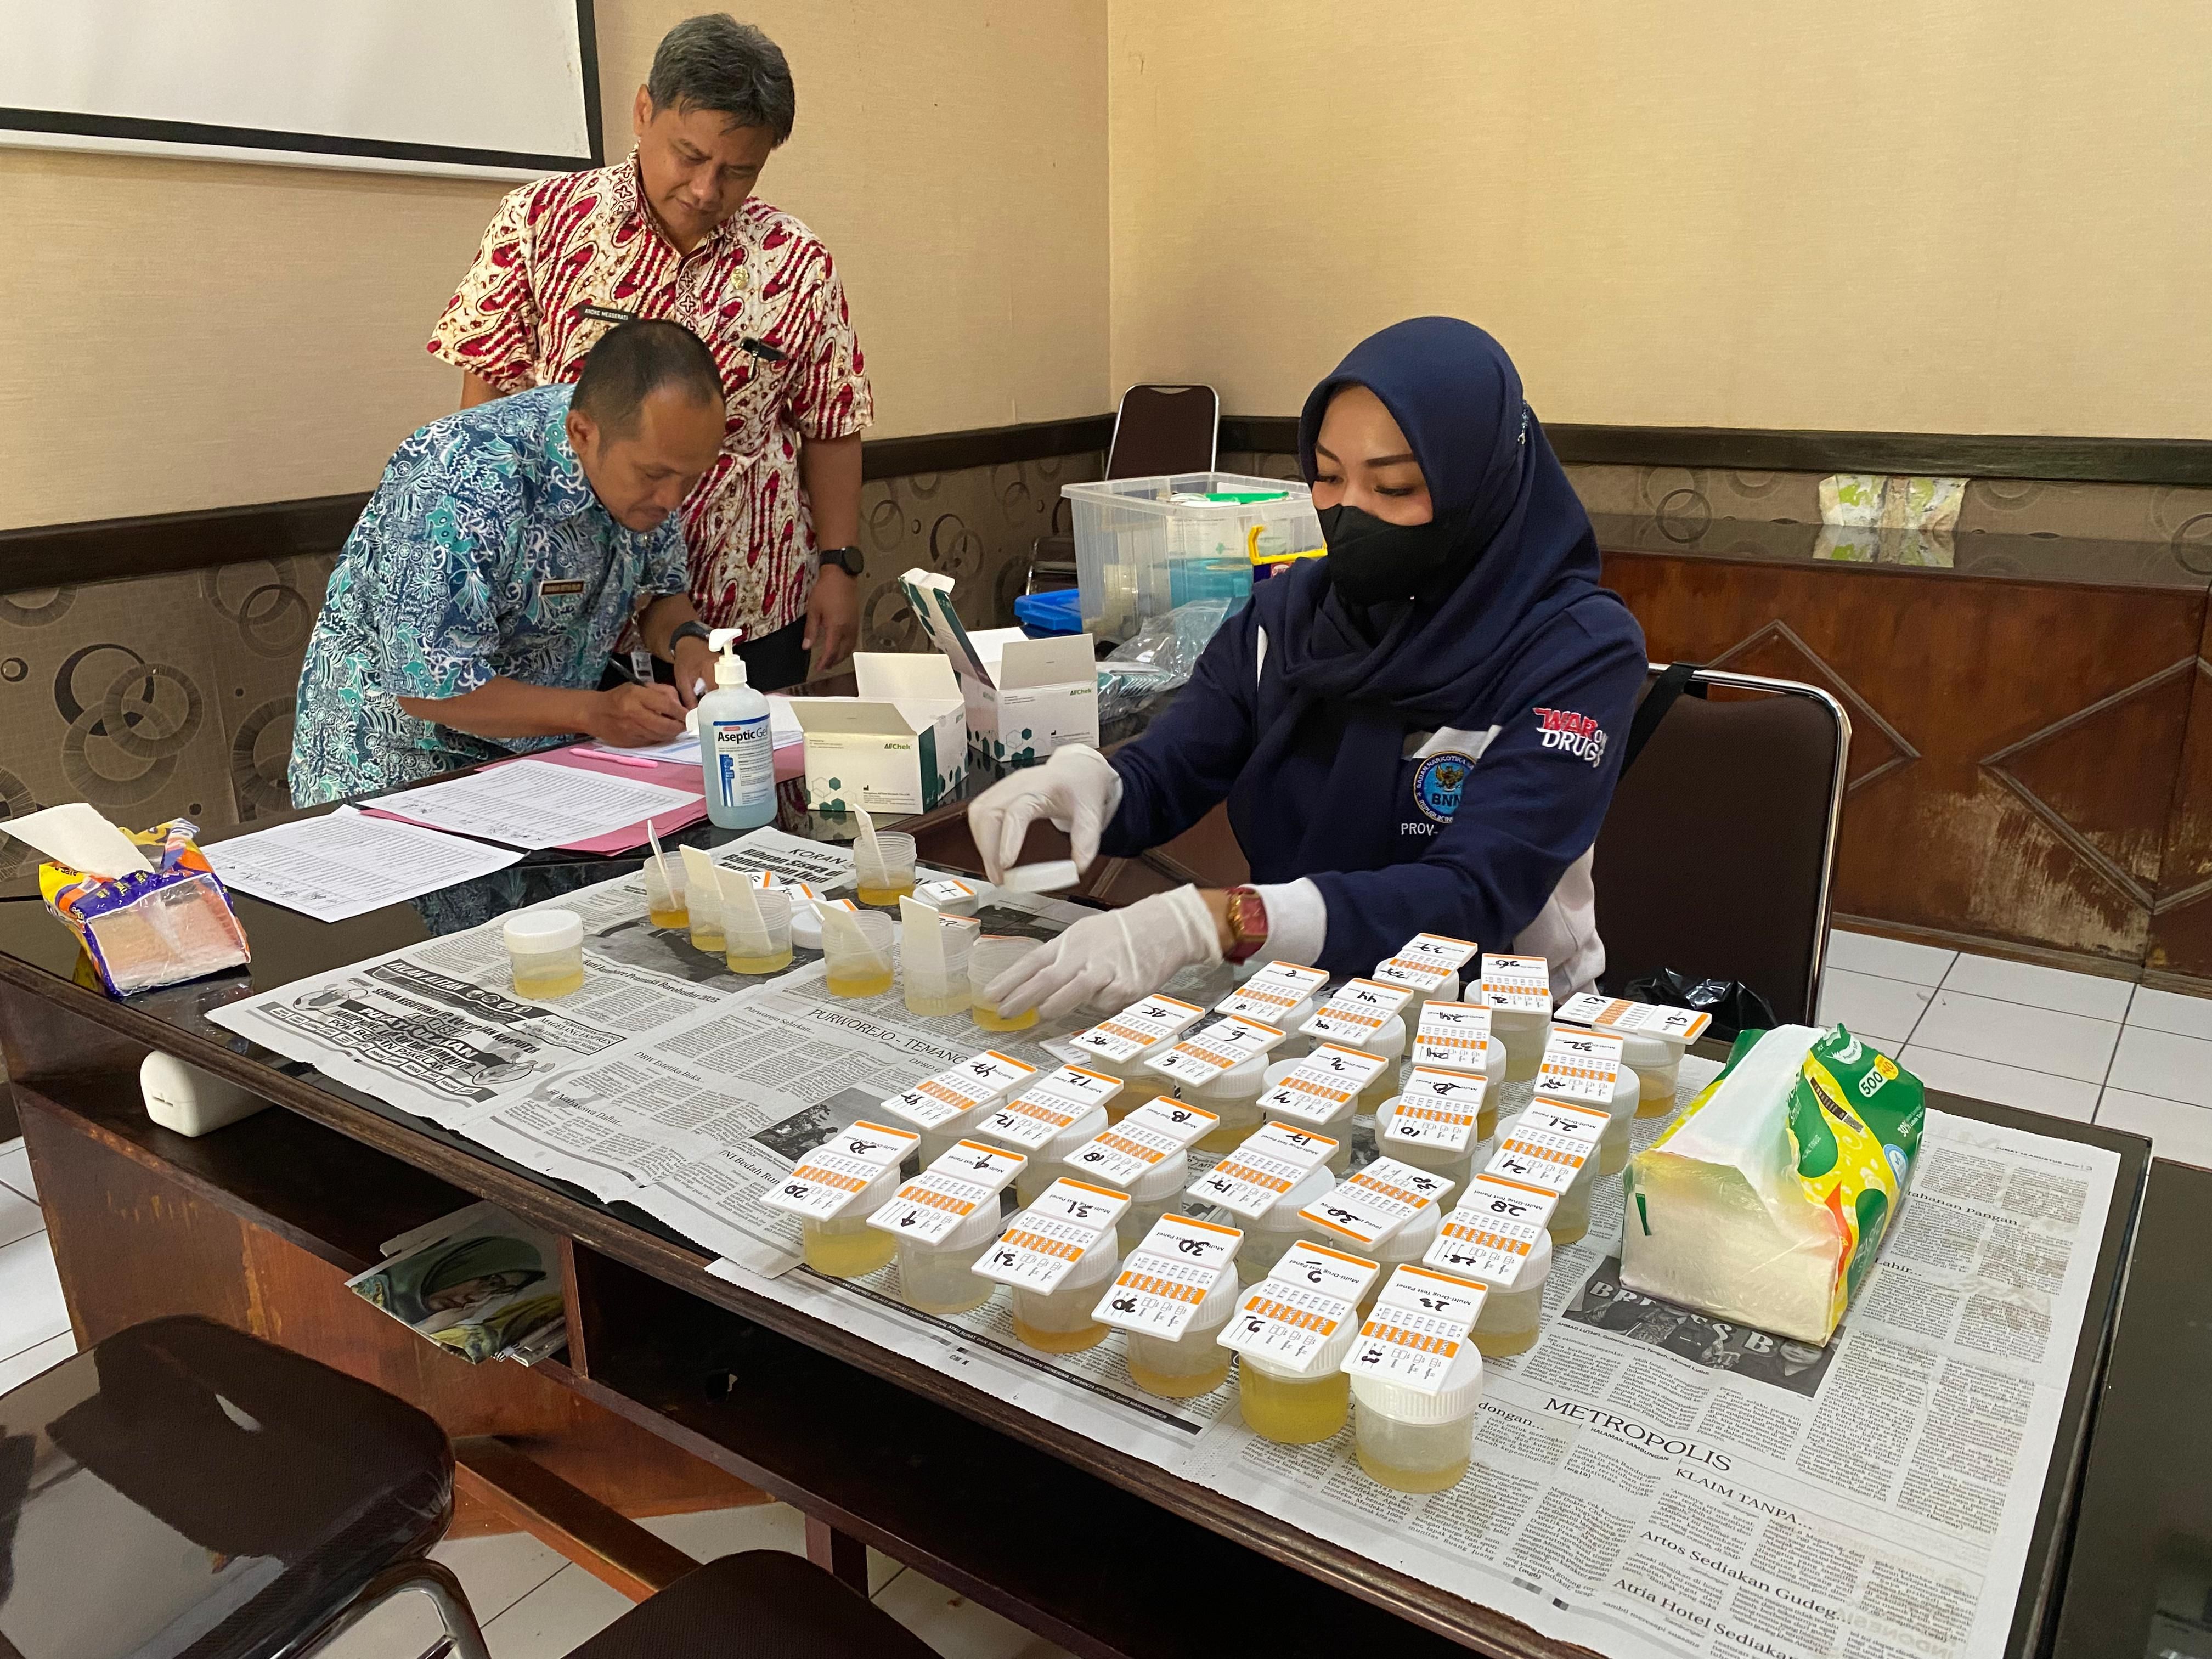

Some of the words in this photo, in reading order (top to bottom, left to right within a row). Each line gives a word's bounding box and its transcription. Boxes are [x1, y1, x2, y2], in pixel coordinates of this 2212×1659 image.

[718, 730, 755, 744] Aseptic
[1532, 707, 1598, 741] WAR
[741, 849, 789, 864] Ribuan
[786, 860, 829, 873] Siswa
[828, 869, 847, 877] di
[788, 848, 848, 864] KORAN
[657, 982, 700, 999] Borobudur
[744, 1005, 781, 1023] Purworejo
[808, 1008, 895, 1041] PURWOREJO
[1860, 1071, 1883, 1095] 500
[734, 1157, 762, 1176] Bedah
[1043, 1365, 1070, 1379] MENERIMA
[1072, 1377, 1094, 1389] MEMINTA
[1128, 1400, 1168, 1420] NARASUMBER
[1543, 1397, 1732, 1472] METROPOLIS
[1590, 1427, 1624, 1443] HALAMAN
[1624, 1440, 1669, 1462] SAMBUNGAN
[1356, 1498, 1384, 1513] Merdeka
[1386, 1510, 1404, 1521] 100%
[1675, 1468, 1734, 1498] KLAIM
[1739, 1492, 1813, 1530] TANPA...
[1443, 1538, 1467, 1551] Ruang
[1641, 1530, 1686, 1555] Artos
[1689, 1550, 1771, 1592] Sediakan
[1775, 1587, 1852, 1626] Gudeg...
[1613, 1578, 1656, 1604] Atria
[1661, 1596, 1711, 1629] Hotel
[1714, 1622, 1799, 1659] Sediaka
